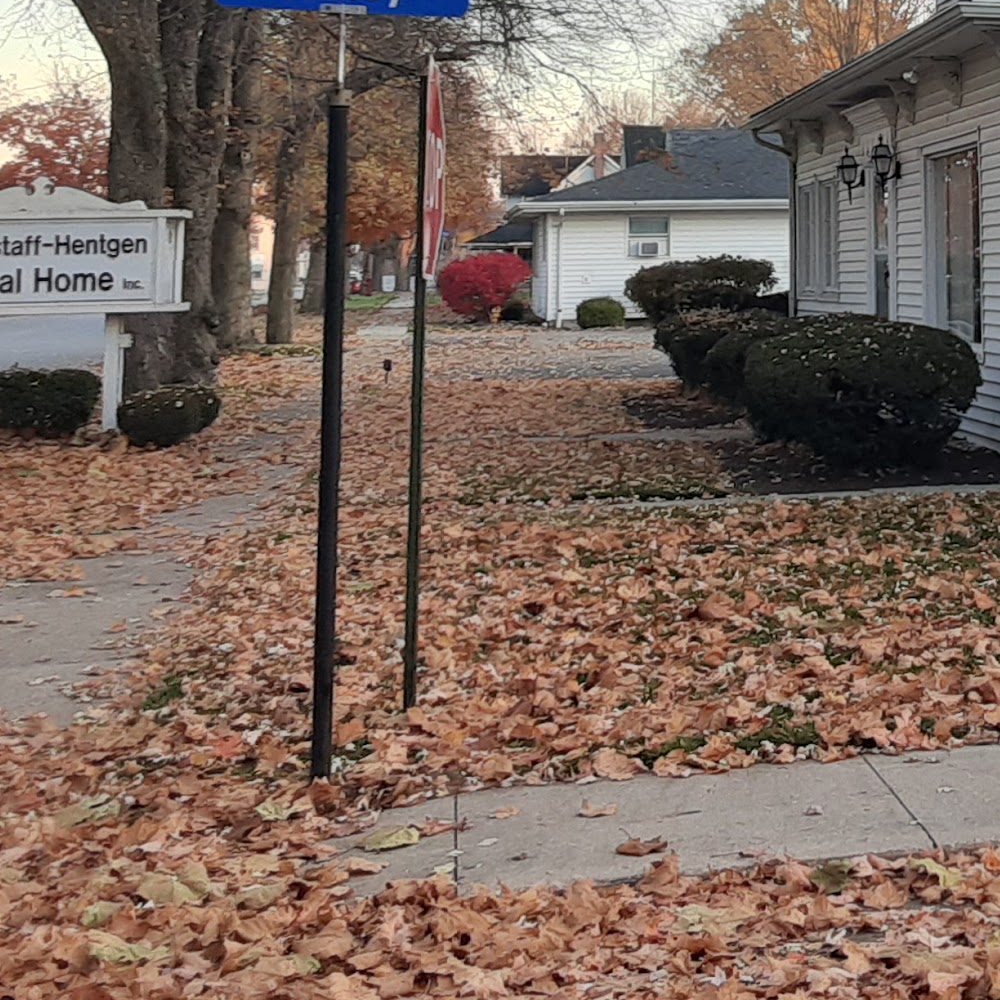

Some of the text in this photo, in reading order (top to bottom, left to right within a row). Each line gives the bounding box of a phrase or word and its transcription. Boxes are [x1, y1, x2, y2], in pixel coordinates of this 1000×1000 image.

[0, 233, 148, 259] taff-Hentgen
[33, 267, 115, 293] Home
[122, 278, 145, 290] Inc.
